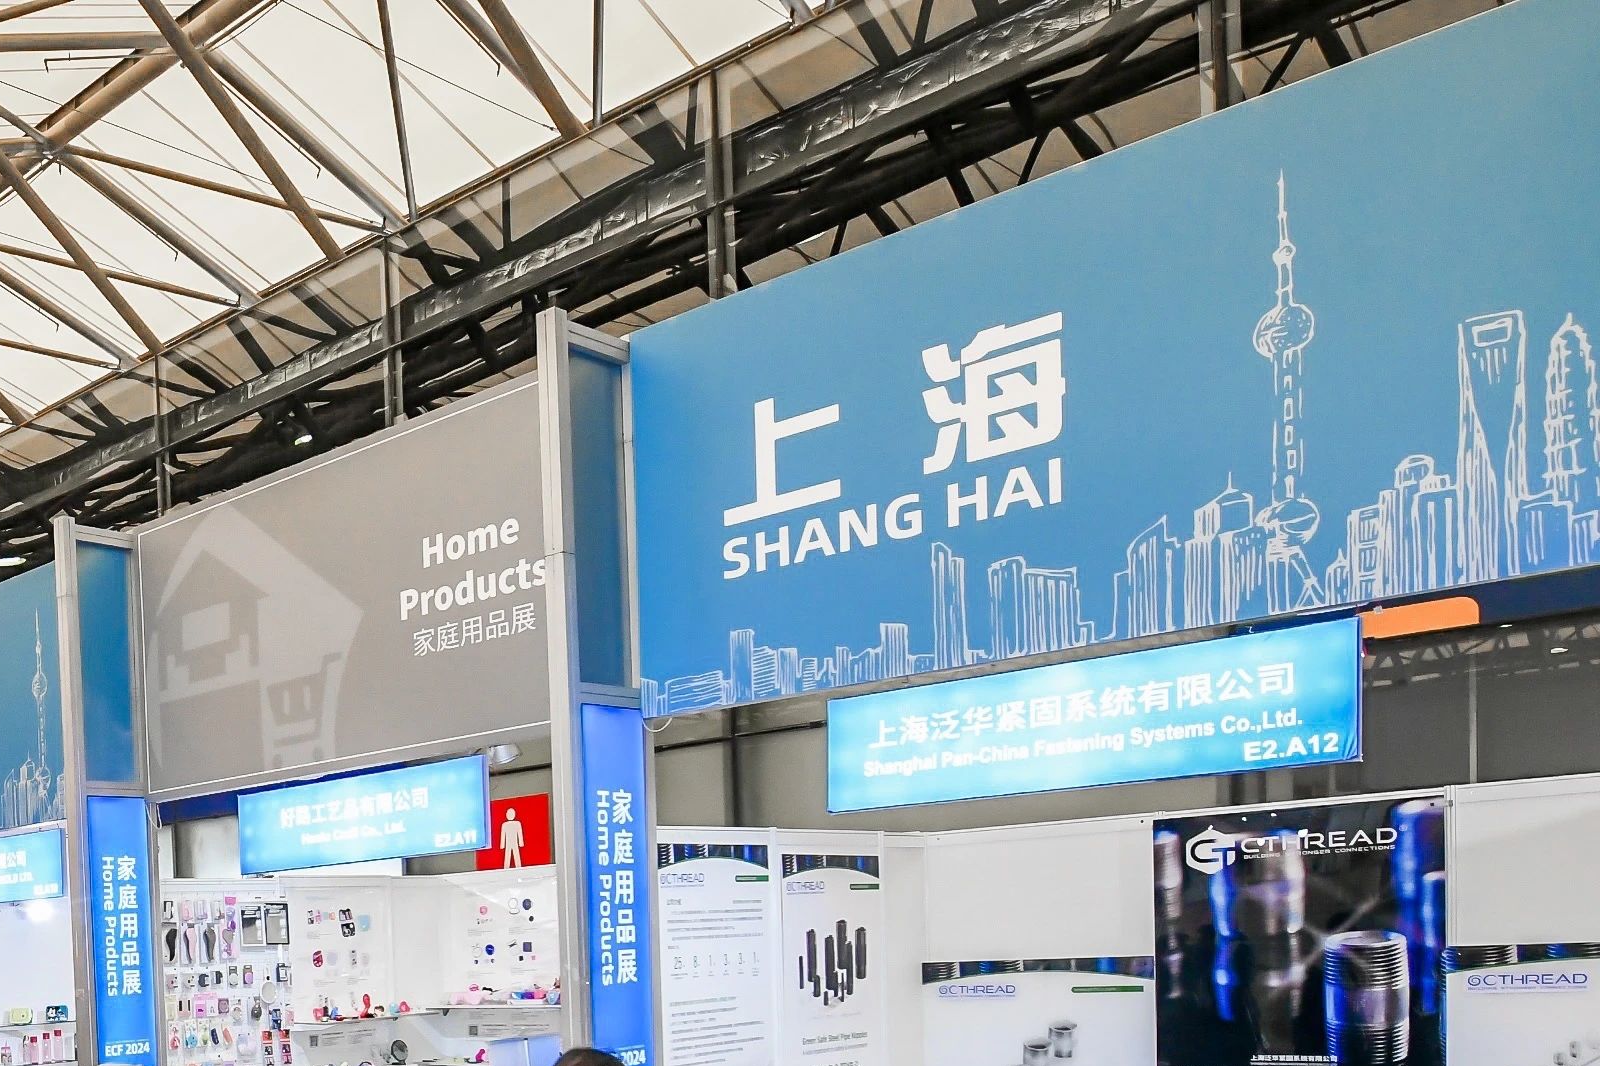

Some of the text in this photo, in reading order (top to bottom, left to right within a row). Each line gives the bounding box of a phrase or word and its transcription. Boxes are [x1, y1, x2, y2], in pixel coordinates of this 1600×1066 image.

[723, 311, 1067, 526] 上海
[422, 517, 521, 569] Home
[723, 457, 1064, 579] SHANG HAI
[400, 555, 549, 622] Products
[412, 602, 538, 658] 家庭用品展
[863, 707, 1304, 779] Shanghai Pan-China Fastening Systems Co.,Ltd.
[868, 661, 1296, 750] 上海泛华紧固系统有限公司
[1242, 732, 1340, 762] E2.A12
[101, 855, 120, 997] Home Products
[115, 855, 142, 996] 家庭用品展
[596, 789, 614, 986] Home Products
[610, 788, 638, 985] 家庭用品展
[105, 1041, 150, 1057] ECF 2024
